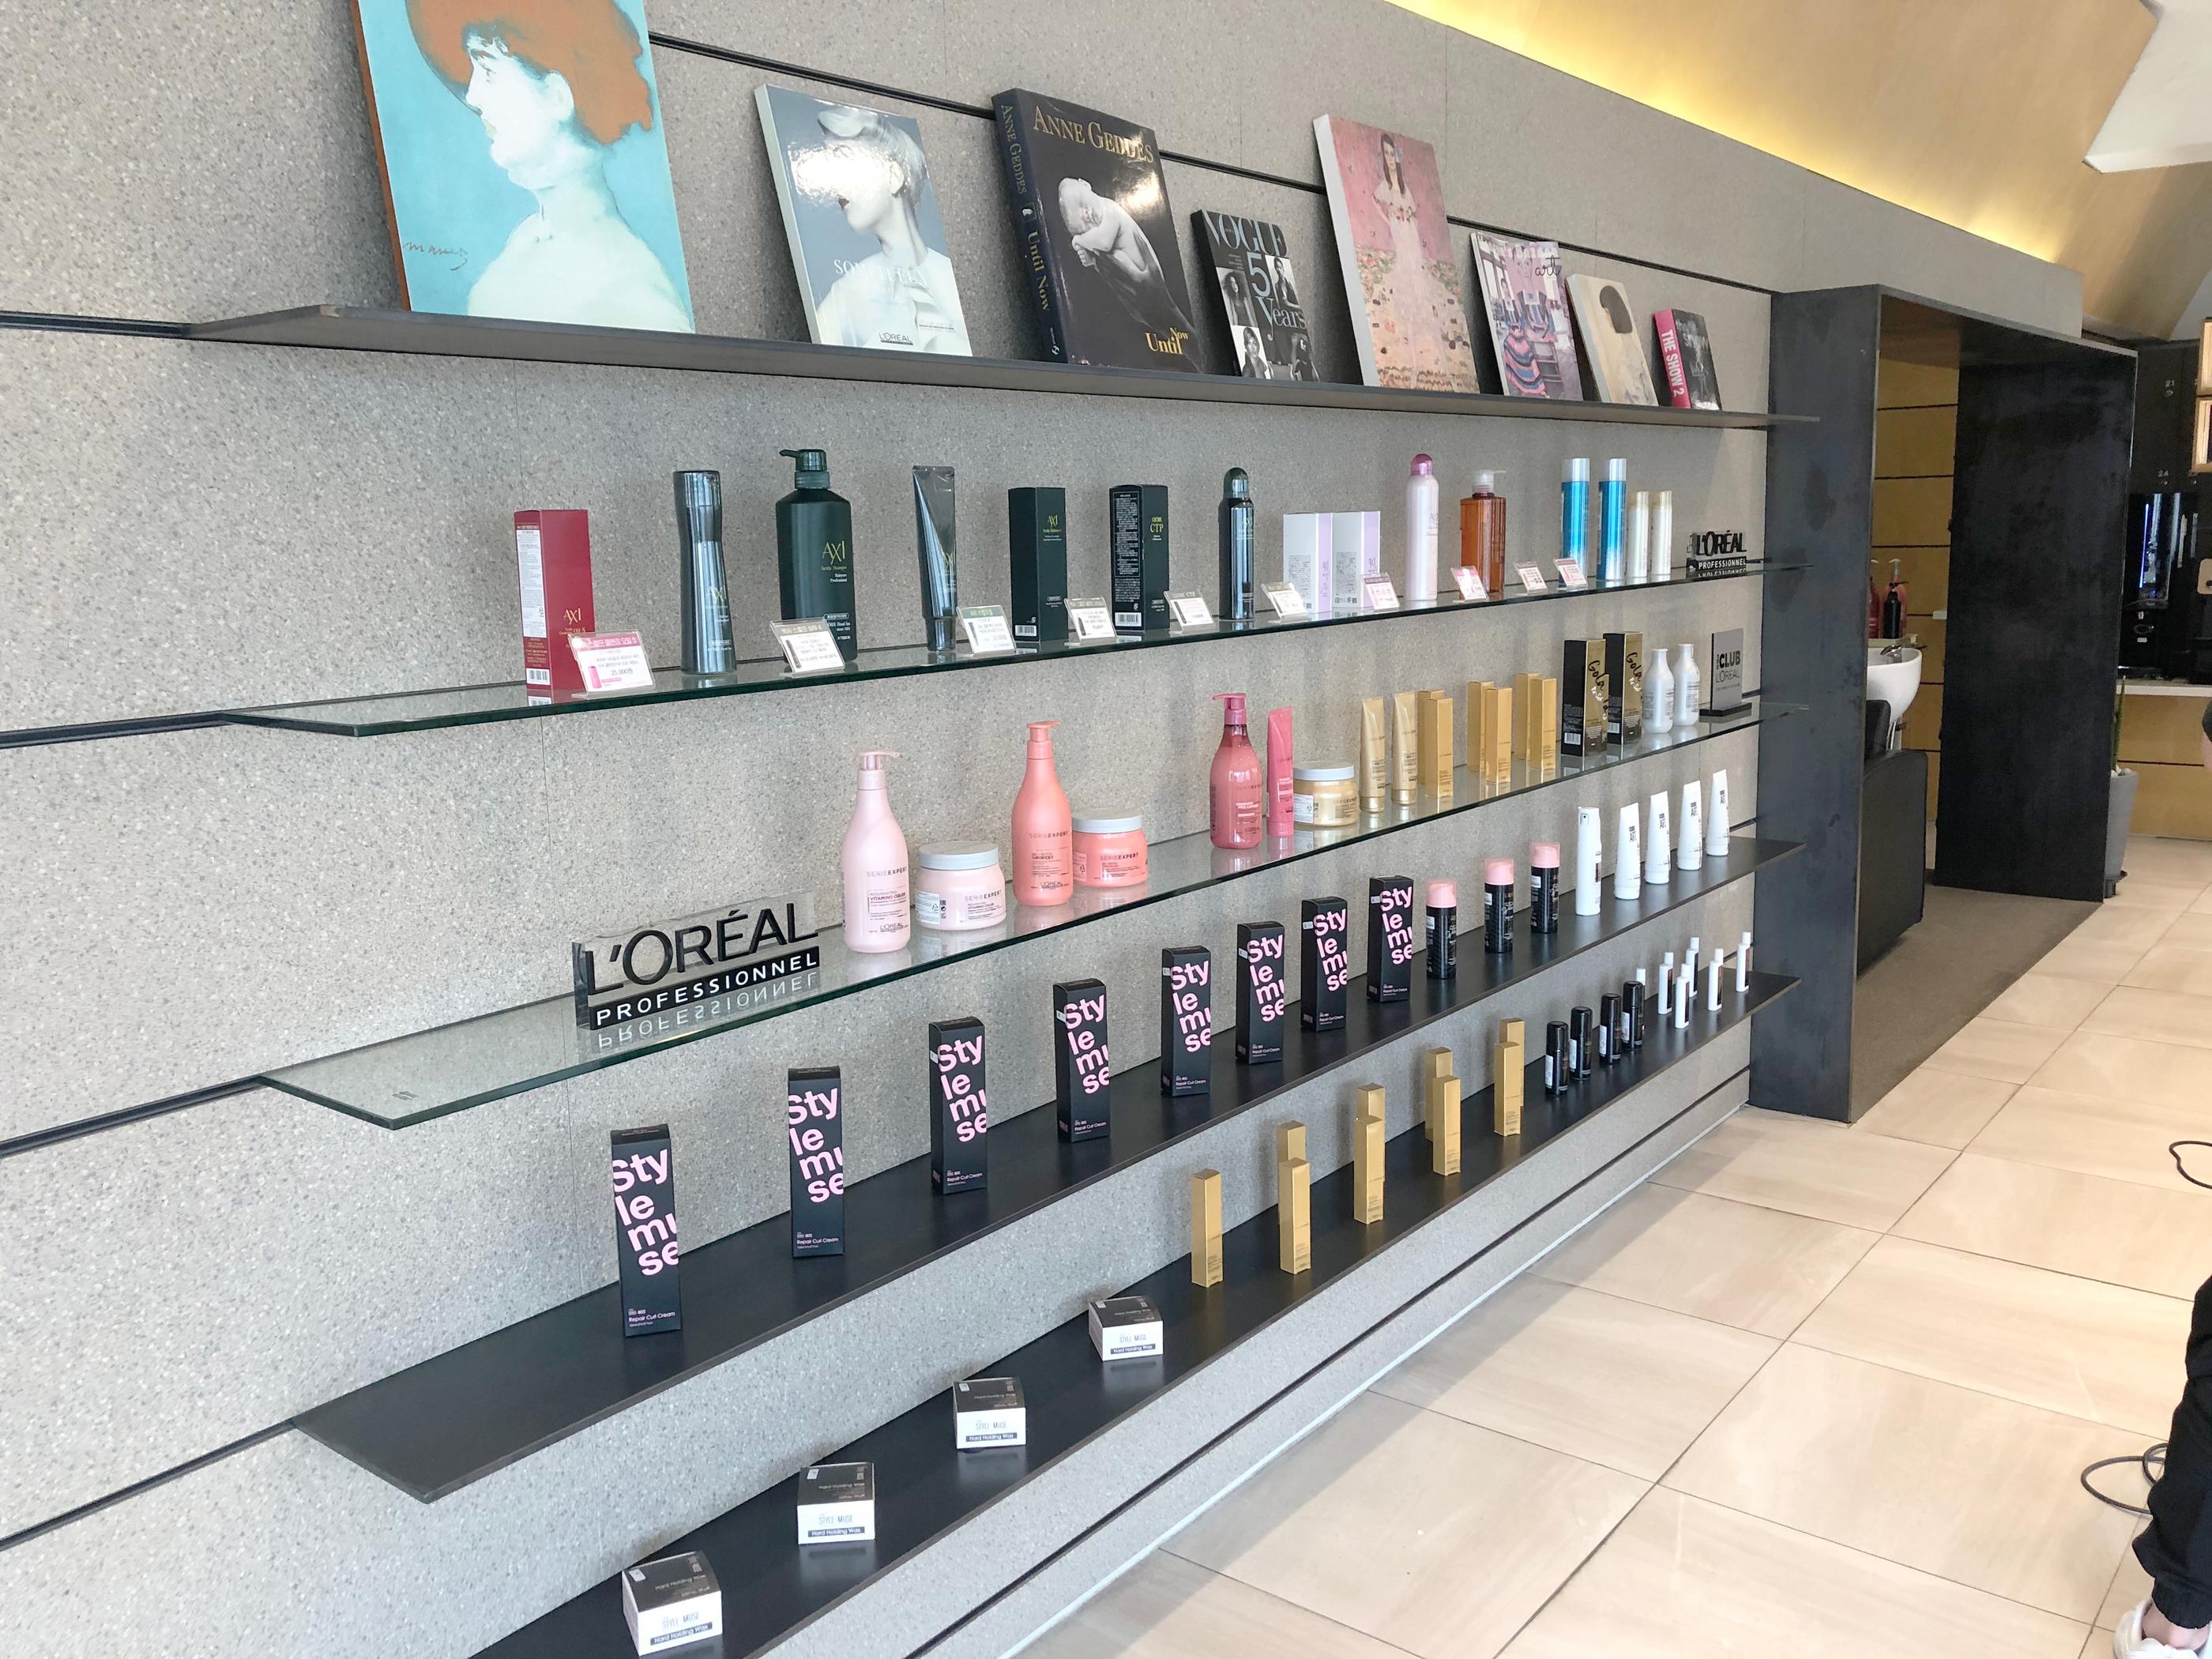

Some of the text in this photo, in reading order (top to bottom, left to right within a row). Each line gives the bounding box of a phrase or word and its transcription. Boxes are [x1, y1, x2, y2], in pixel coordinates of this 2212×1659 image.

[1033, 105, 1153, 164] ANNE GEDDES
[1001, 104, 1050, 311] ANNE GEDDES Until Now
[1202, 209, 1288, 256] VOGUE
[1146, 327, 1189, 355] Until Now
[1661, 329, 1684, 397] THE SHOW 2
[1150, 523, 1164, 532] CTP
[822, 541, 845, 565] AXI
[1695, 530, 1747, 556] L'ORÉAL
[1698, 558, 1746, 570] PROFESSIONNEL
[563, 608, 581, 625] AXI
[1720, 650, 1740, 668] CLUB
[1379, 886, 1413, 912] Sty
[1313, 908, 1347, 937] Sty
[1382, 912, 1403, 932] le
[585, 903, 818, 995] L'ORÉAL
[1247, 935, 1283, 964] Sty
[1316, 938, 1338, 958] le
[596, 952, 817, 1026] PROFESSIONNEL
[1170, 960, 1209, 991] Sty
[1250, 965, 1273, 987] le
[1064, 994, 1104, 1029] Sty
[1172, 992, 1198, 1015] le
[938, 1035, 983, 1072] Sty
[1068, 1029, 1095, 1055] le
[940, 1073, 971, 1100] le
[788, 1088, 838, 1125] Sty
[790, 1127, 825, 1156] le
[612, 1149, 669, 1192] Sty
[615, 1194, 654, 1226] le
[818, 1514, 853, 1524] STYLE MUSE
[654, 1624, 709, 1643] Hard Holding Wax
[662, 1611, 699, 1629] STYLE MUSE
